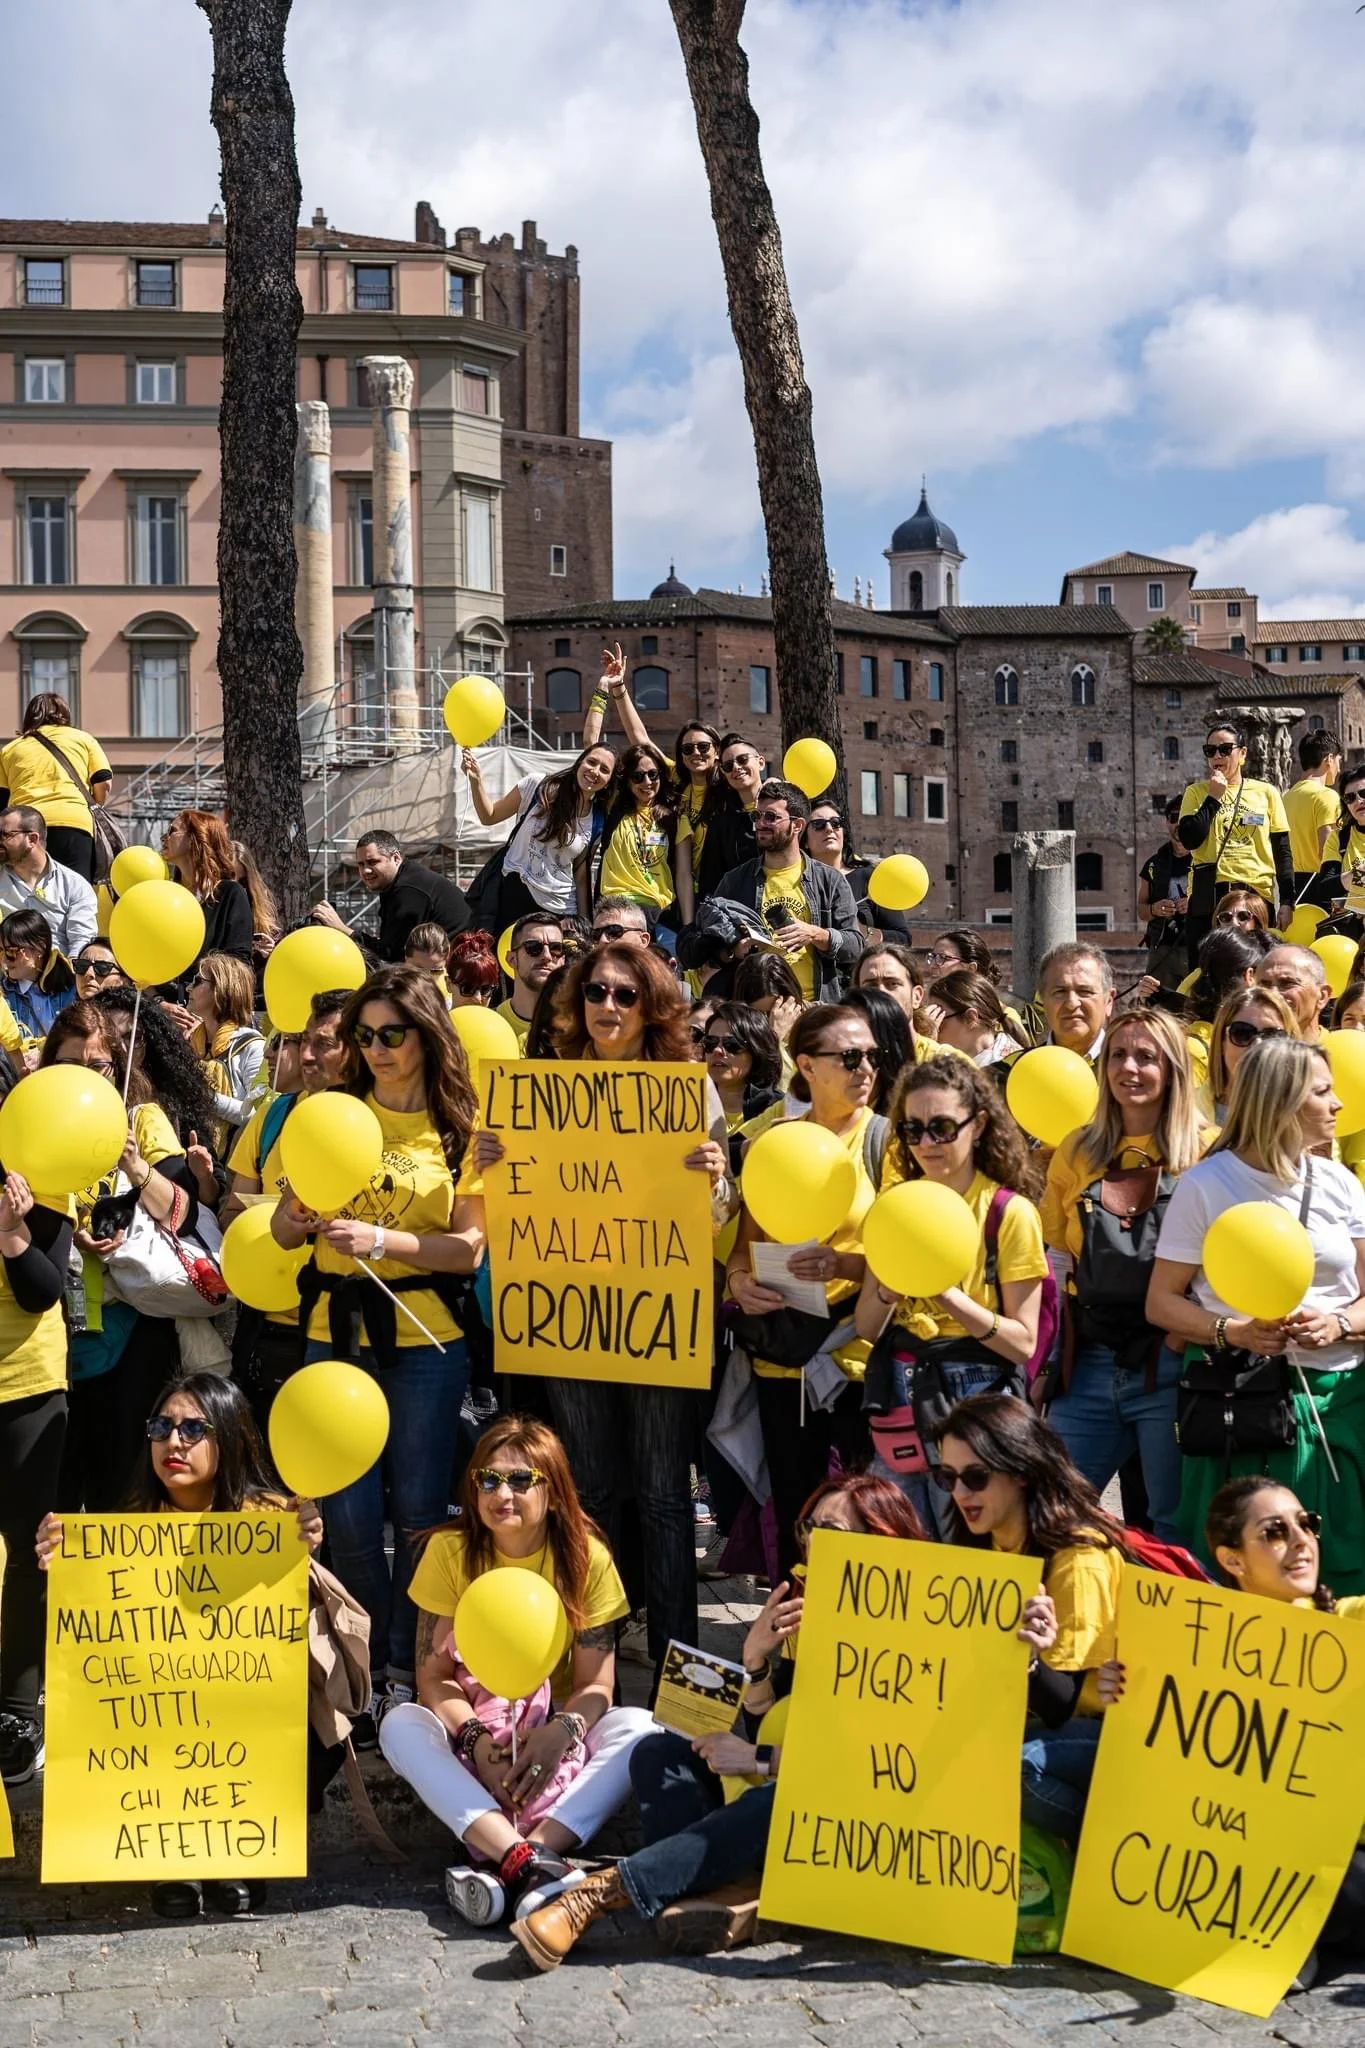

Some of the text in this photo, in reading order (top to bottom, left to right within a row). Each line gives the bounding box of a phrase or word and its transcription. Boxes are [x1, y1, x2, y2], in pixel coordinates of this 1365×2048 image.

[485, 1066, 706, 1134] L'ENDOMETRIOSI
[559, 1159, 623, 1194] UNA
[508, 1215, 690, 1269] MALATTIA
[499, 1280, 701, 1361] CRONICA!
[60, 1520, 282, 1560] L'ENDOMETRIOSI
[154, 1563, 221, 1598] UNA
[836, 1558, 1023, 1633] NON SONO
[1136, 1579, 1175, 1608] UN
[55, 1603, 305, 1645] MALATTIA SOCIALE
[1184, 1597, 1348, 1694] FIGLIO
[83, 1650, 273, 1688] CHE RIGUARDA
[98, 1689, 212, 1730] TUTTI,
[1144, 1673, 1289, 1784] NON
[88, 1741, 247, 1773] NON SOLO
[870, 1742, 917, 1794] HO
[120, 1788, 160, 1812] CHI
[183, 1785, 219, 1810] NE
[1191, 1796, 1248, 1841] UNA
[782, 1810, 1018, 1902] L'ENDOMETRIOSI
[1111, 1831, 1316, 1950] CURA!!!
